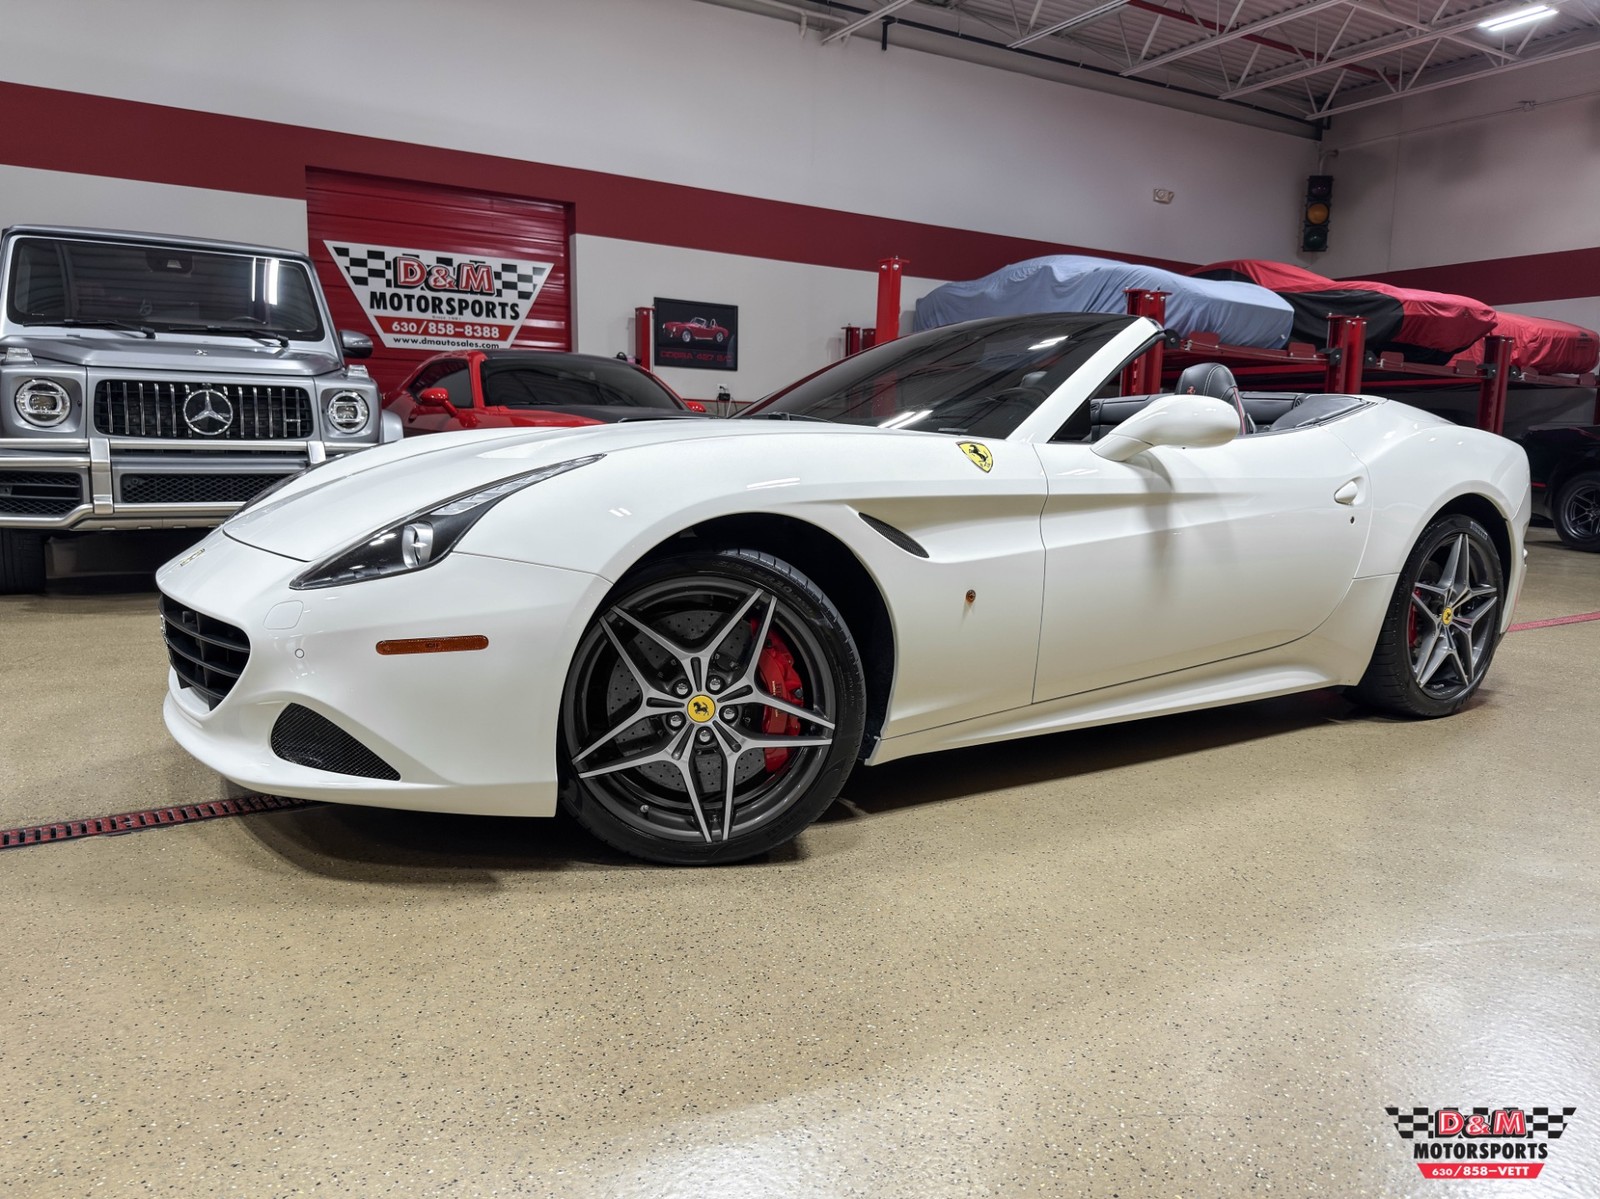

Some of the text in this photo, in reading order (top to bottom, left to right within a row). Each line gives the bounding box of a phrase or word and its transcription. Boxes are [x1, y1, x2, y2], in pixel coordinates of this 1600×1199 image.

[394, 256, 496, 296] D&M
[369, 291, 520, 320] MOTORSPORTS
[392, 322, 500, 338] 630/858-8388
[393, 336, 499, 350] www.dmautosales.com
